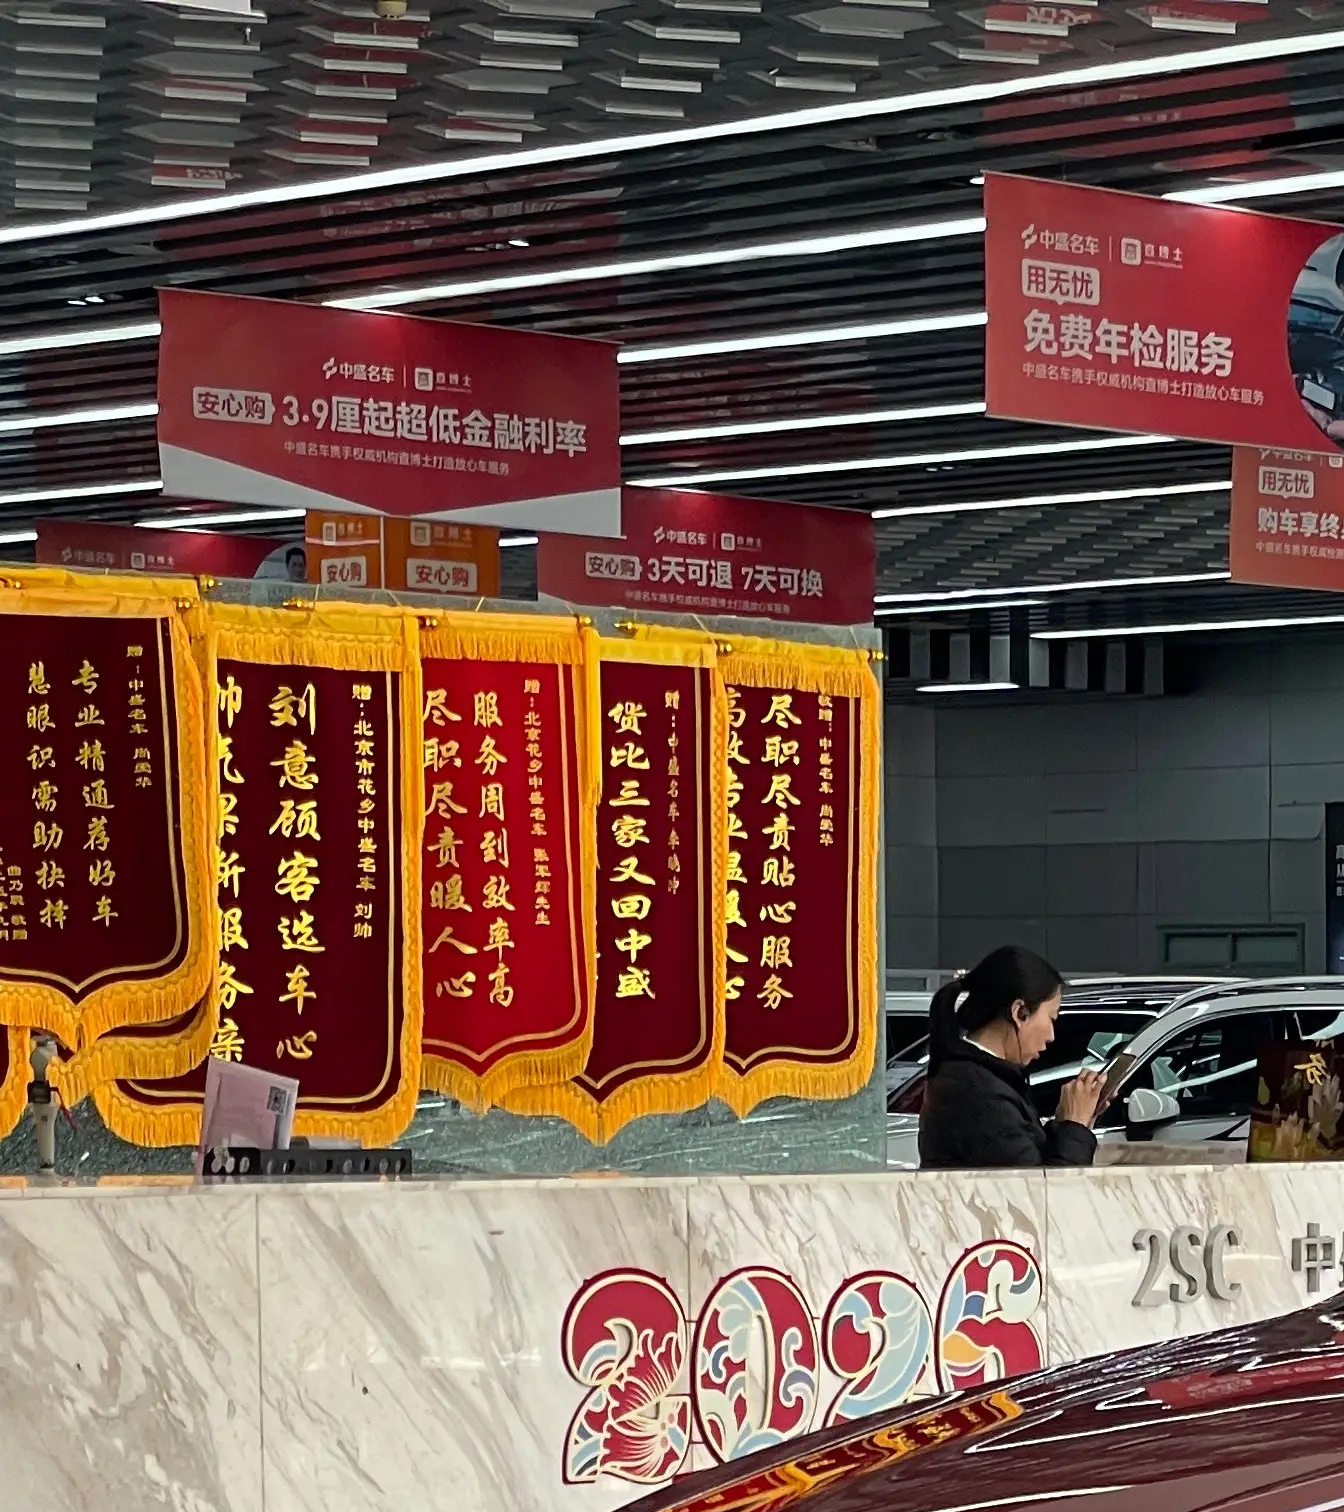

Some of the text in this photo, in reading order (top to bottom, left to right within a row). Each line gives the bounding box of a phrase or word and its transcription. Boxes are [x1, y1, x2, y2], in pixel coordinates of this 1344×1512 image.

[1040, 230, 1100, 256] 中盛名车
[1027, 265, 1093, 299] 用无忧
[340, 363, 394, 383] 中盛名车
[1023, 308, 1234, 378] 免费年检服务
[198, 391, 587, 458] 安心购 3.9厘起超低金融利率
[1261, 470, 1310, 494] 用无忧
[667, 530, 707, 545] 中盛名车
[326, 564, 362, 583] 安心购
[415, 564, 468, 587] 安心购
[589, 555, 823, 597] 安心购 3天可退 7天可换
[26, 661, 69, 929] 慧眼识需助抉择
[72, 660, 119, 927] 专业精通荐好车
[268, 682, 325, 1060] 刘意顾客选车心
[422, 688, 477, 999] 尽职尽责暖人心
[473, 691, 515, 1007] 服务周到效率高
[608, 701, 656, 1000] 货比三家又回中盛
[757, 693, 802, 1010] 尽职尽责贴心服务
[1132, 1224, 1245, 1306] 2SC
[561, 1240, 1043, 1484] 2026
